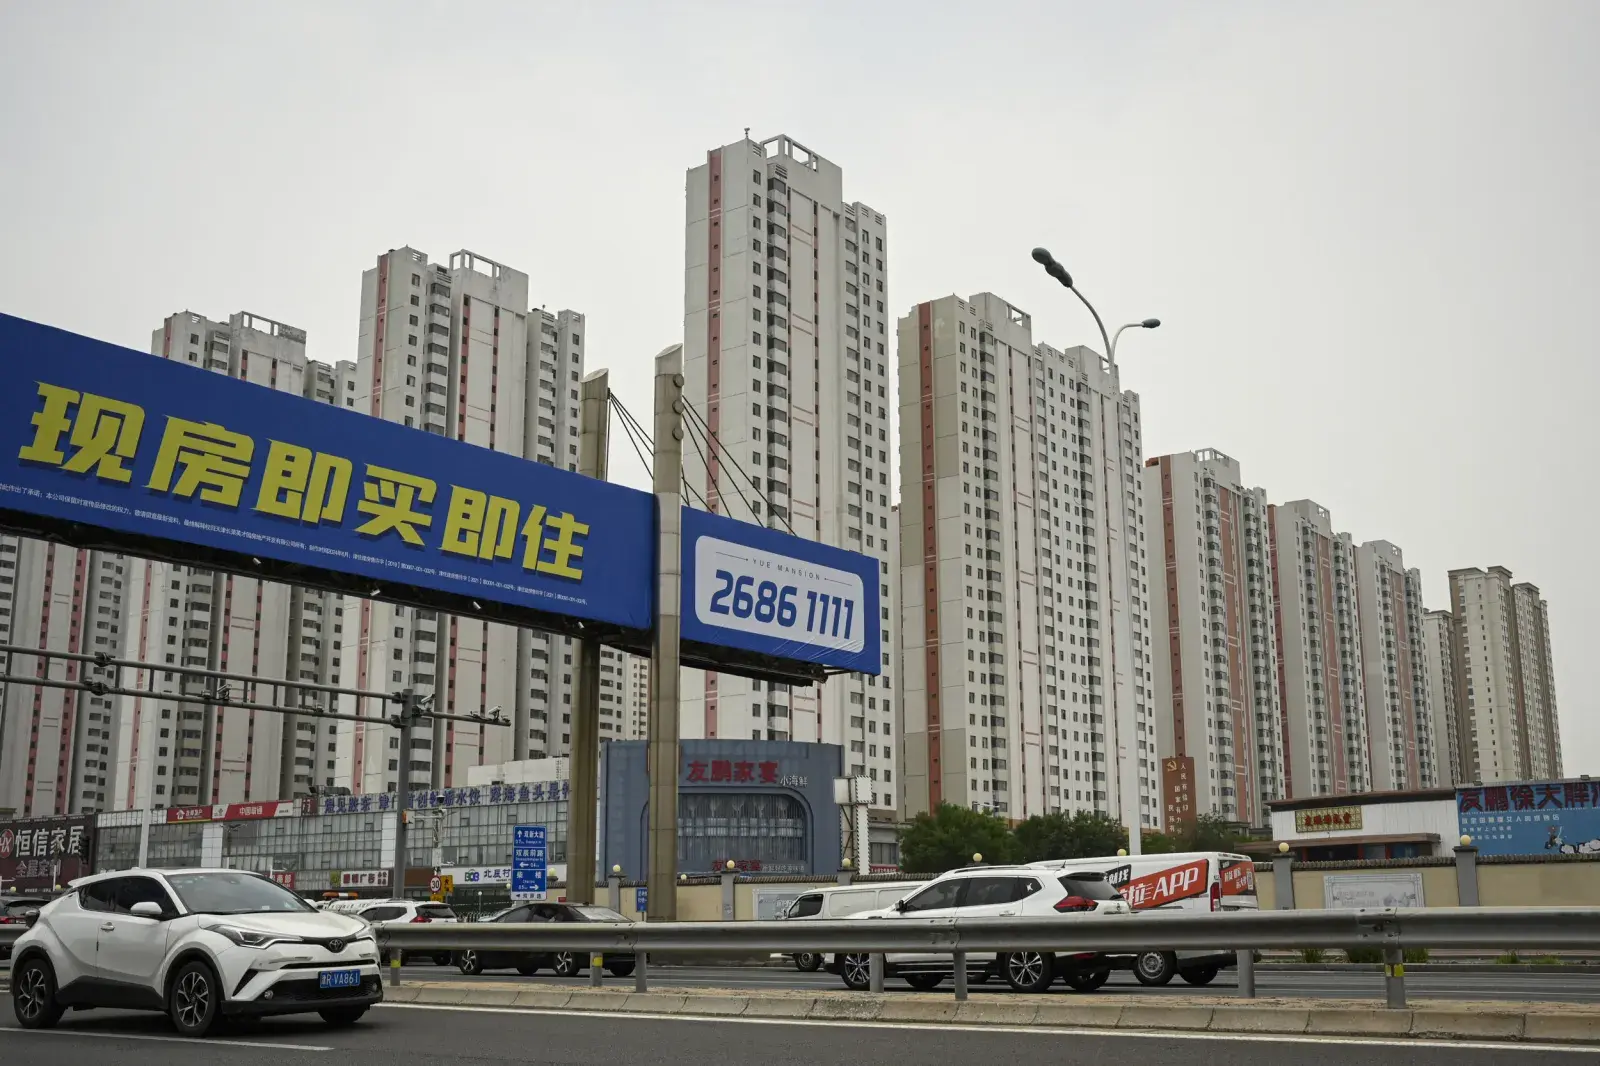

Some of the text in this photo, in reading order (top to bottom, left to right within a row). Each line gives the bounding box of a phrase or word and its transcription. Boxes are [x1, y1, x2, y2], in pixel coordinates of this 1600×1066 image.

[18, 380, 590, 580] 现房即买即住
[752, 558, 821, 581] YUE MANSION
[710, 569, 854, 640] 2686 1111
[686, 760, 779, 784] 友鹏家宴
[779, 775, 808, 788] 小海鲜
[1180, 763, 1189, 811] 人民有信仰
[239, 806, 263, 815] 中国联通
[15, 825, 84, 858] 恒信家居
[712, 860, 761, 872] 友家宴
[431, 880, 440, 889] 30
